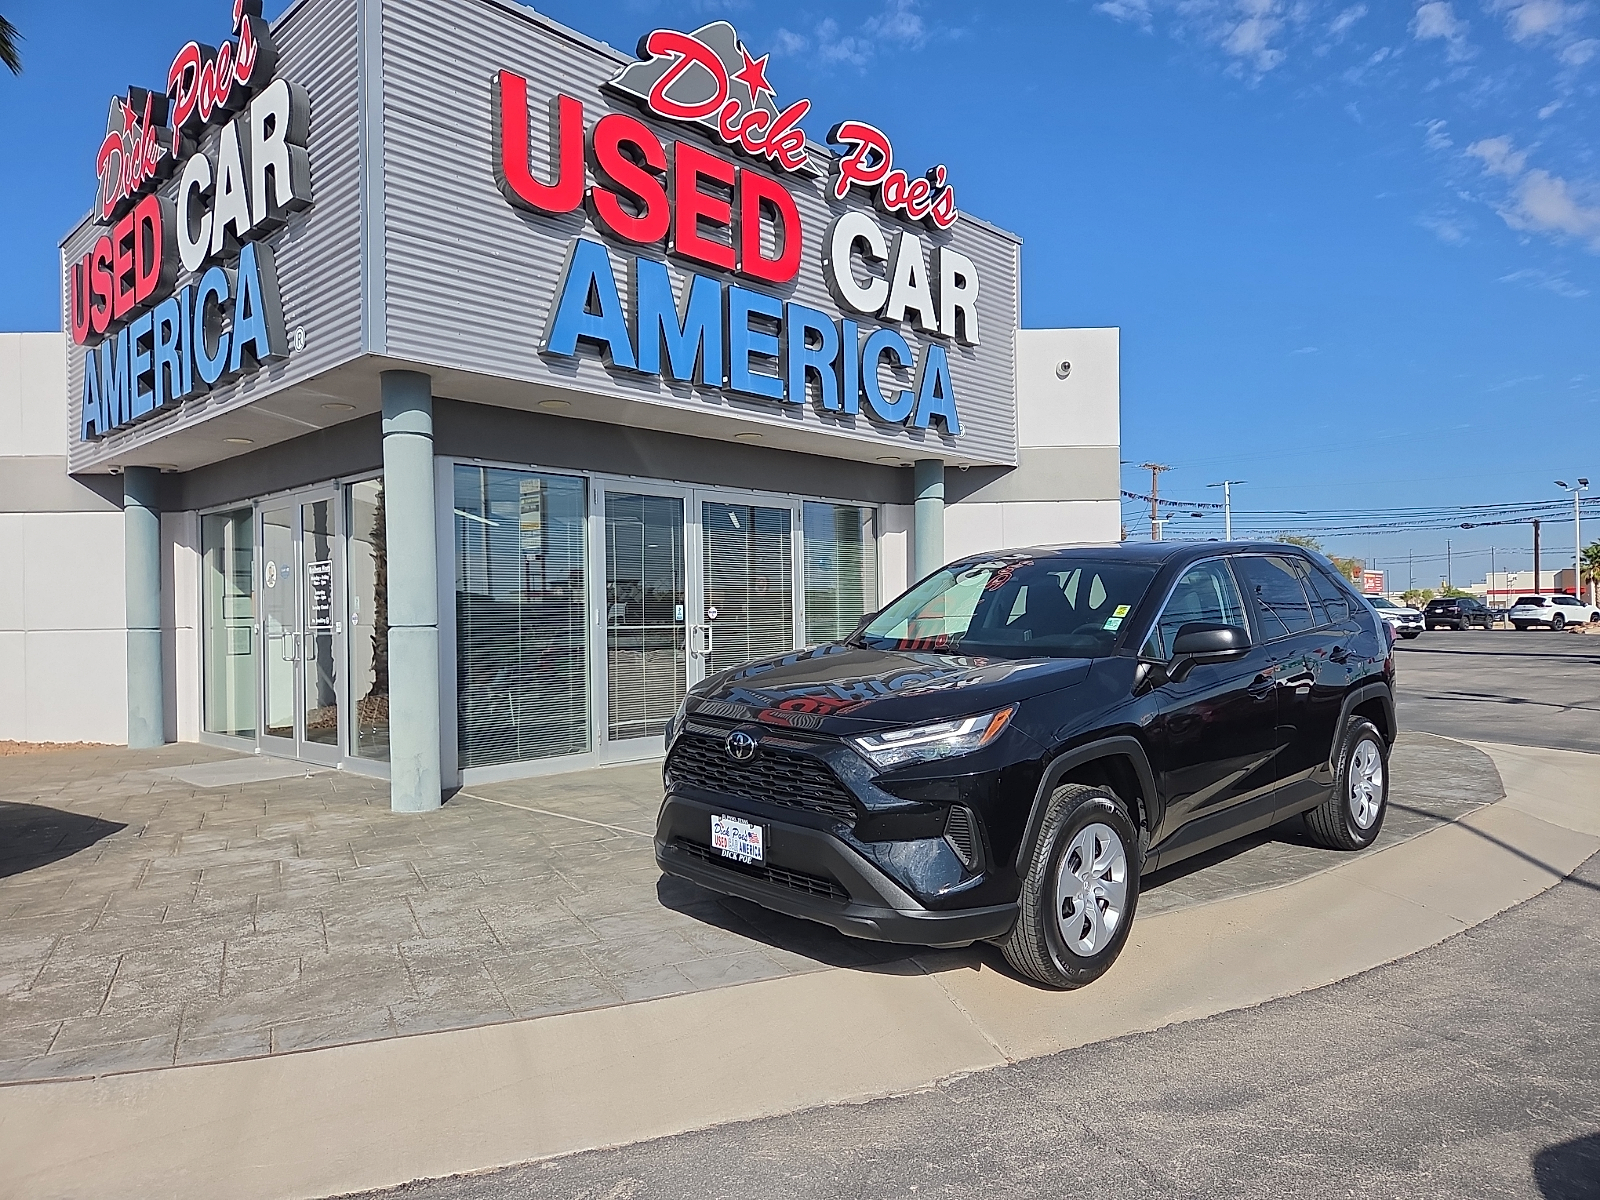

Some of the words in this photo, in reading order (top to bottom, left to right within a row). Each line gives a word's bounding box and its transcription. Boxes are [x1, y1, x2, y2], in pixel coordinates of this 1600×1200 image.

[96, 90, 159, 221] Dick
[166, 0, 258, 160] Poe's
[500, 69, 802, 283] USED
[830, 211, 980, 346] CAR
[644, 28, 810, 172] Dick
[835, 120, 958, 230] Poe's
[71, 194, 163, 345] USED
[177, 78, 293, 272] CAR
[81, 241, 270, 441] AMERICA
[547, 238, 960, 435] AMERICA
[714, 823, 730, 836] Dick
[714, 835, 727, 848] USED
[739, 842, 761, 858] AMERICA
[721, 850, 738, 860] DICK
[739, 855, 752, 864] POE
